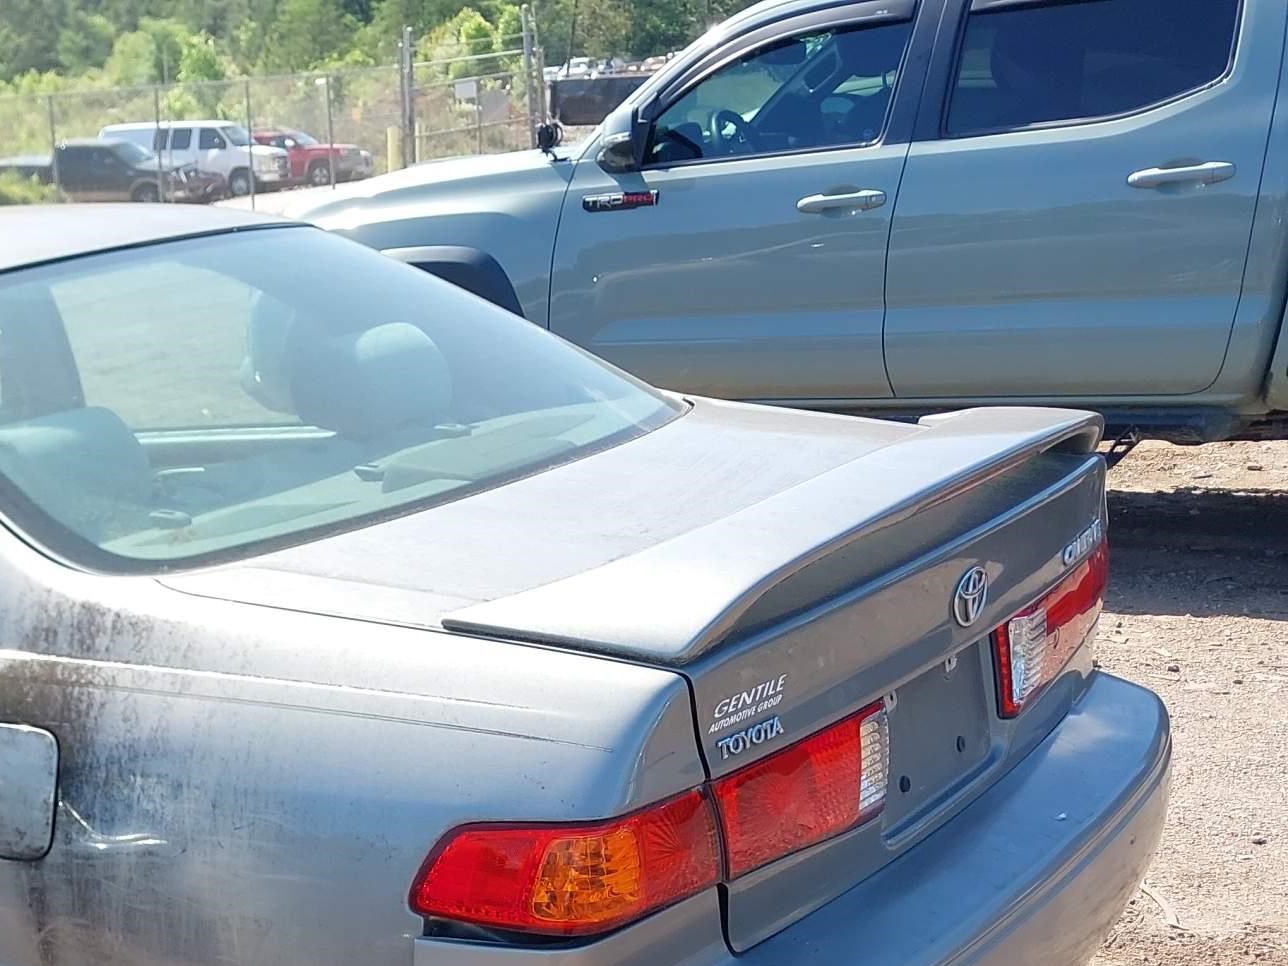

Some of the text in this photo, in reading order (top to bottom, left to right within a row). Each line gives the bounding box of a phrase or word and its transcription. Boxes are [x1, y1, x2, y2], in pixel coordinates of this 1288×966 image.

[584, 195, 624, 209] TRD
[708, 694, 783, 735] AUTOMOTIVE GROUP
[714, 673, 788, 718] GENTILE
[717, 716, 784, 760] TOYOTA
